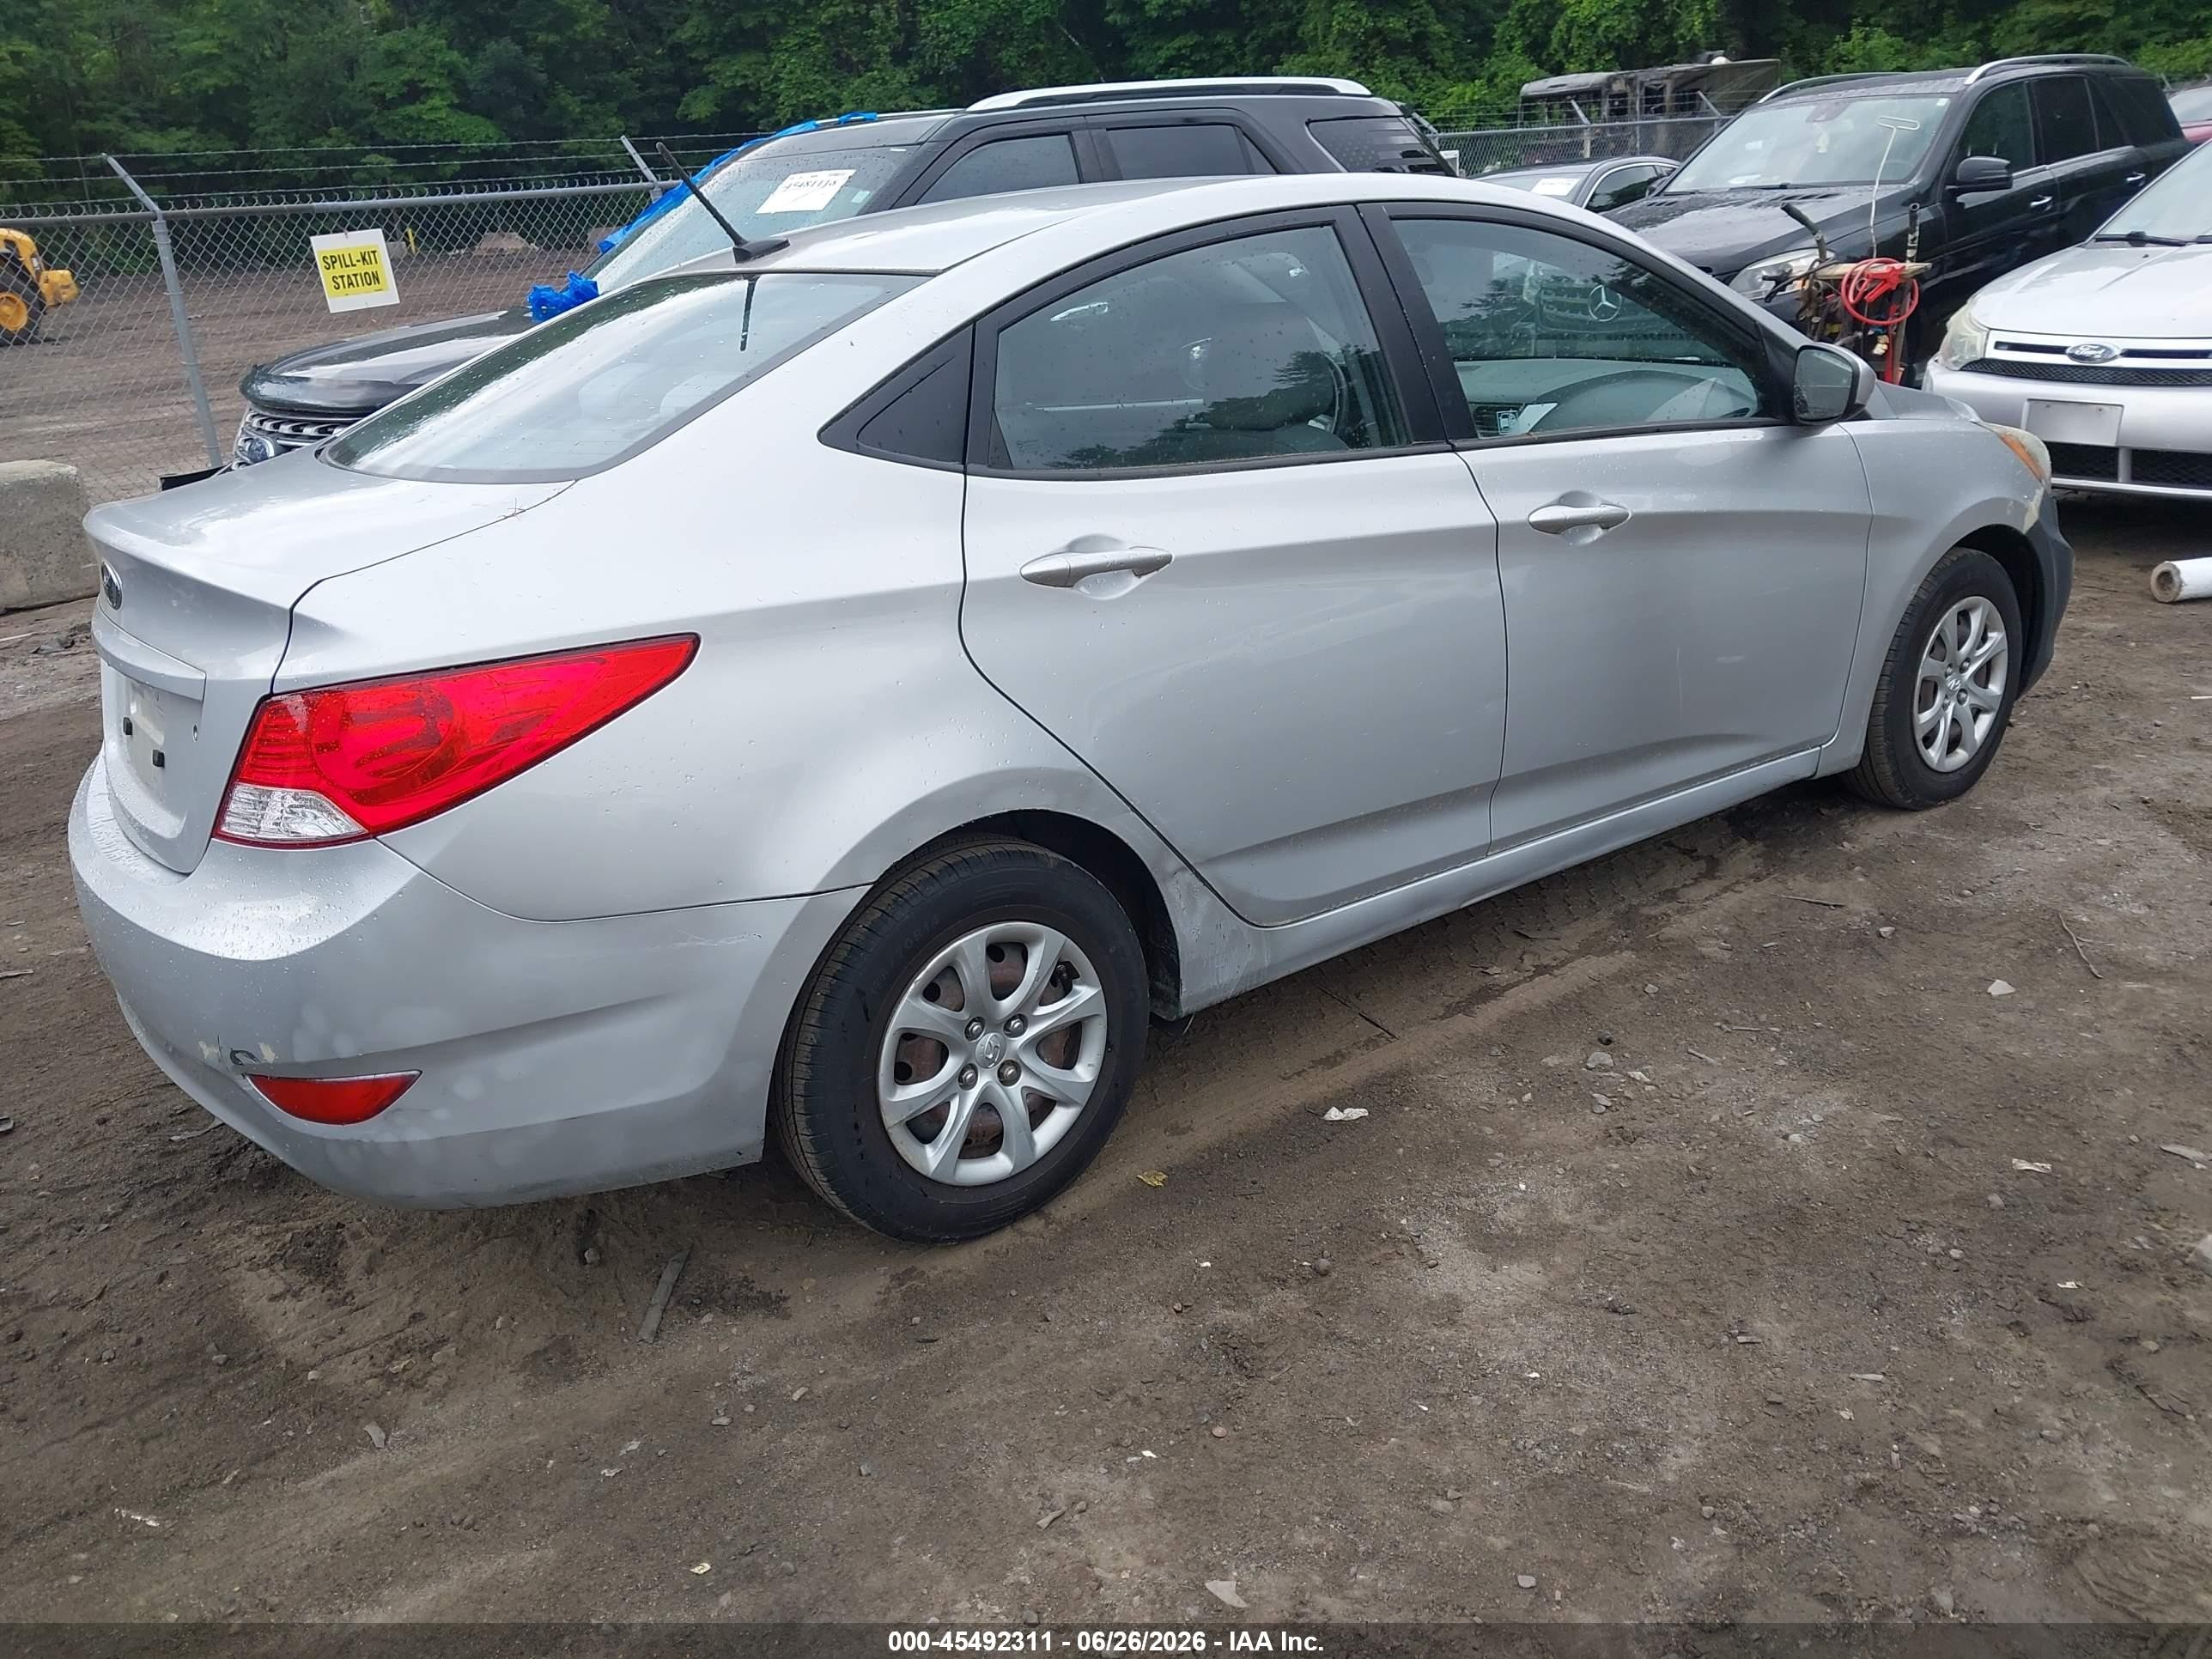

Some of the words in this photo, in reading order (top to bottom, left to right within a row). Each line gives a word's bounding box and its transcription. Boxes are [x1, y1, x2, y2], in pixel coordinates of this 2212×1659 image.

[322, 250, 379, 270] SPILL-KIT
[331, 270, 380, 289] STATION
[2074, 344, 2109, 358] Ford
